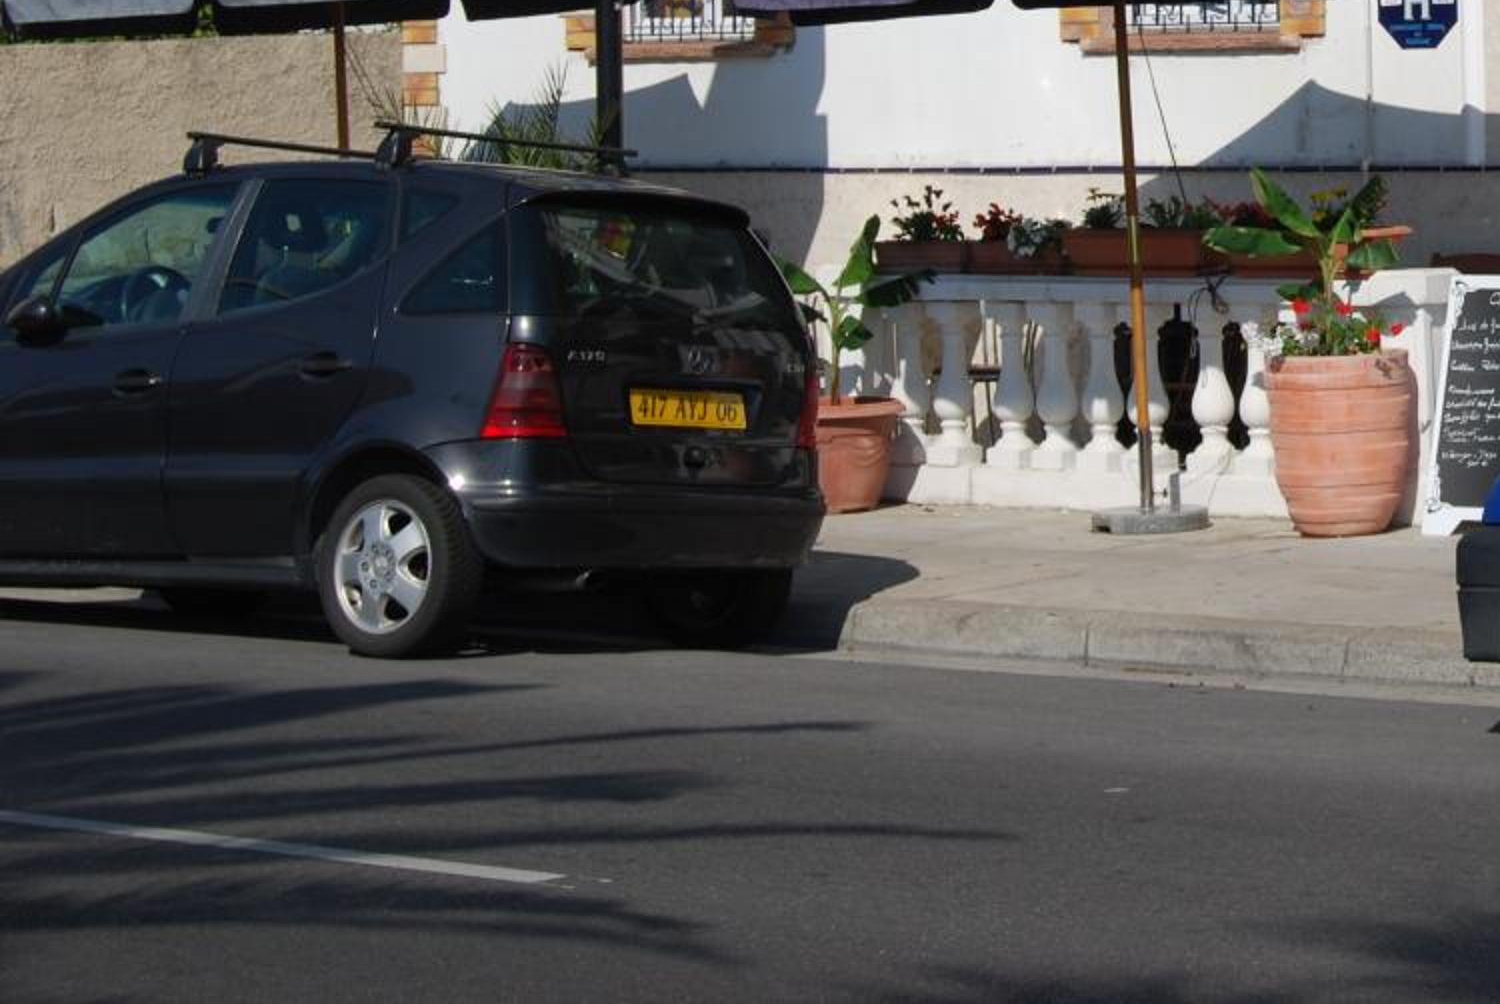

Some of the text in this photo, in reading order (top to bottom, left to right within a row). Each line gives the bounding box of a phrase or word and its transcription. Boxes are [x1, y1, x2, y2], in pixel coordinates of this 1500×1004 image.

[636, 393, 738, 423] 417 AYJ 06
